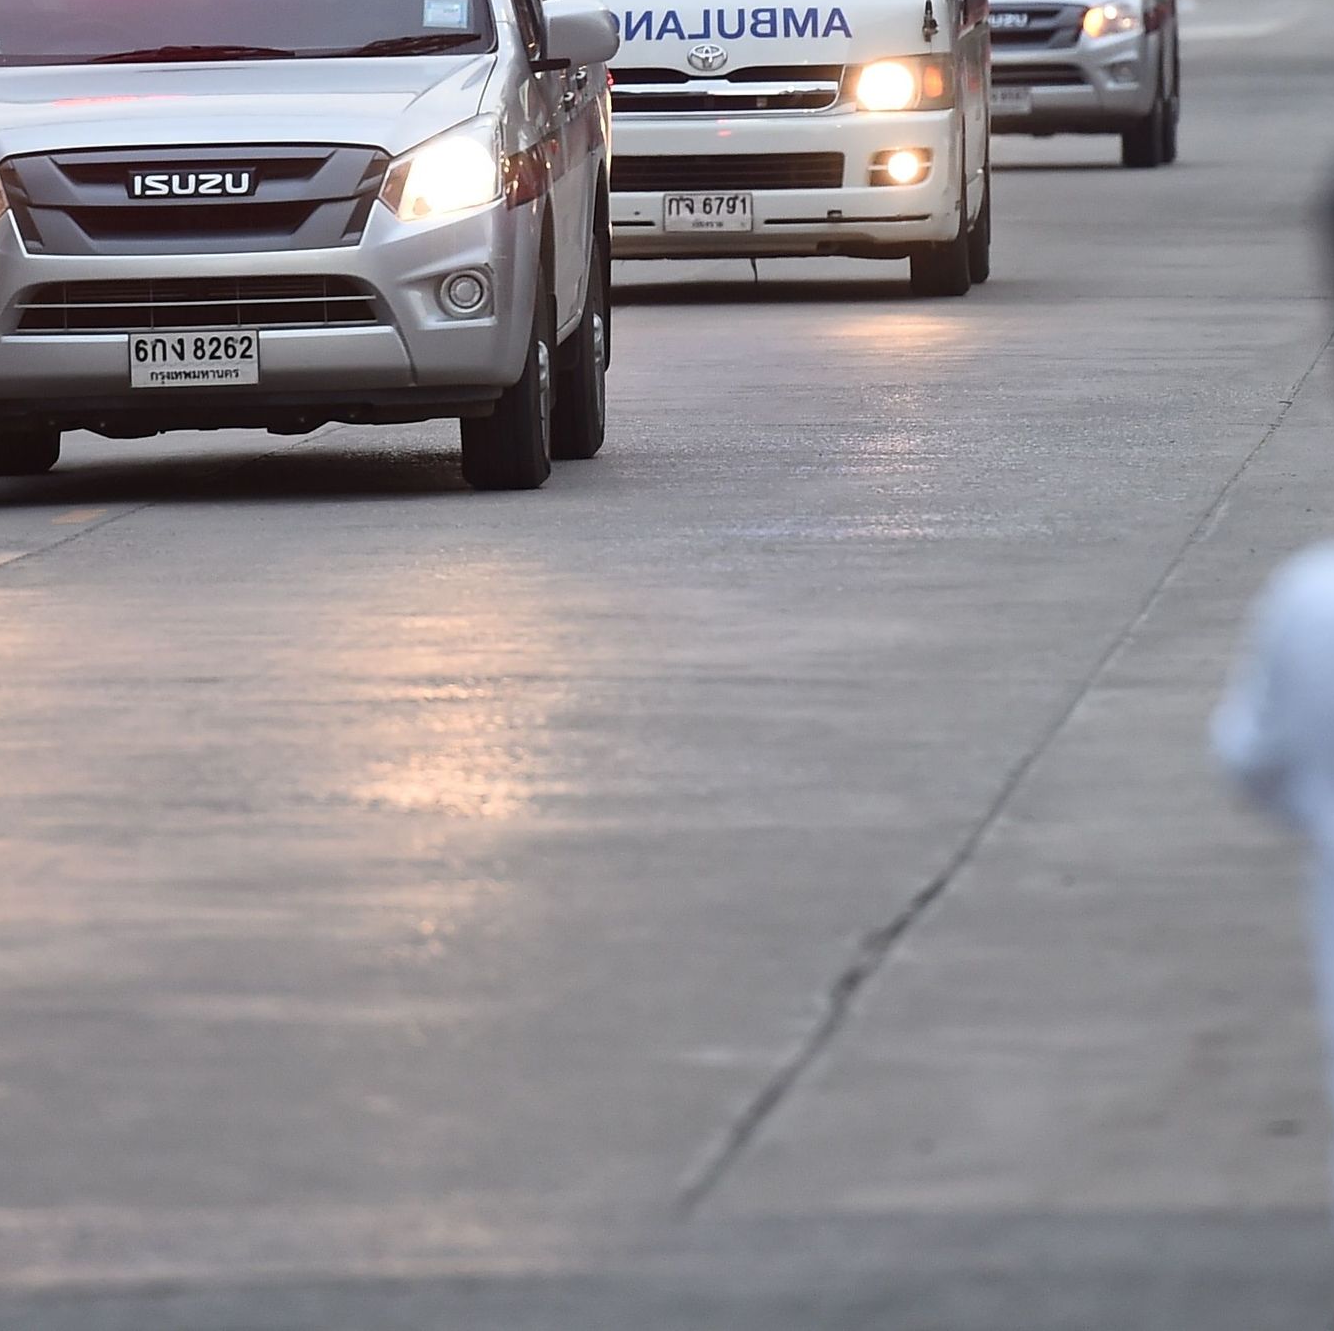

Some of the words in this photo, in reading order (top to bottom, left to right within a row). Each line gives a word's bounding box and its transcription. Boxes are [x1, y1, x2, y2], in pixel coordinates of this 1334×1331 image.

[988, 13, 1028, 28] UZU
[134, 173, 249, 196] ISUZU
[668, 196, 694, 216] กจ
[703, 195, 747, 215] 6791
[193, 336, 253, 360] 8262
[150, 368, 239, 384] กรุงเทพมหานคร
